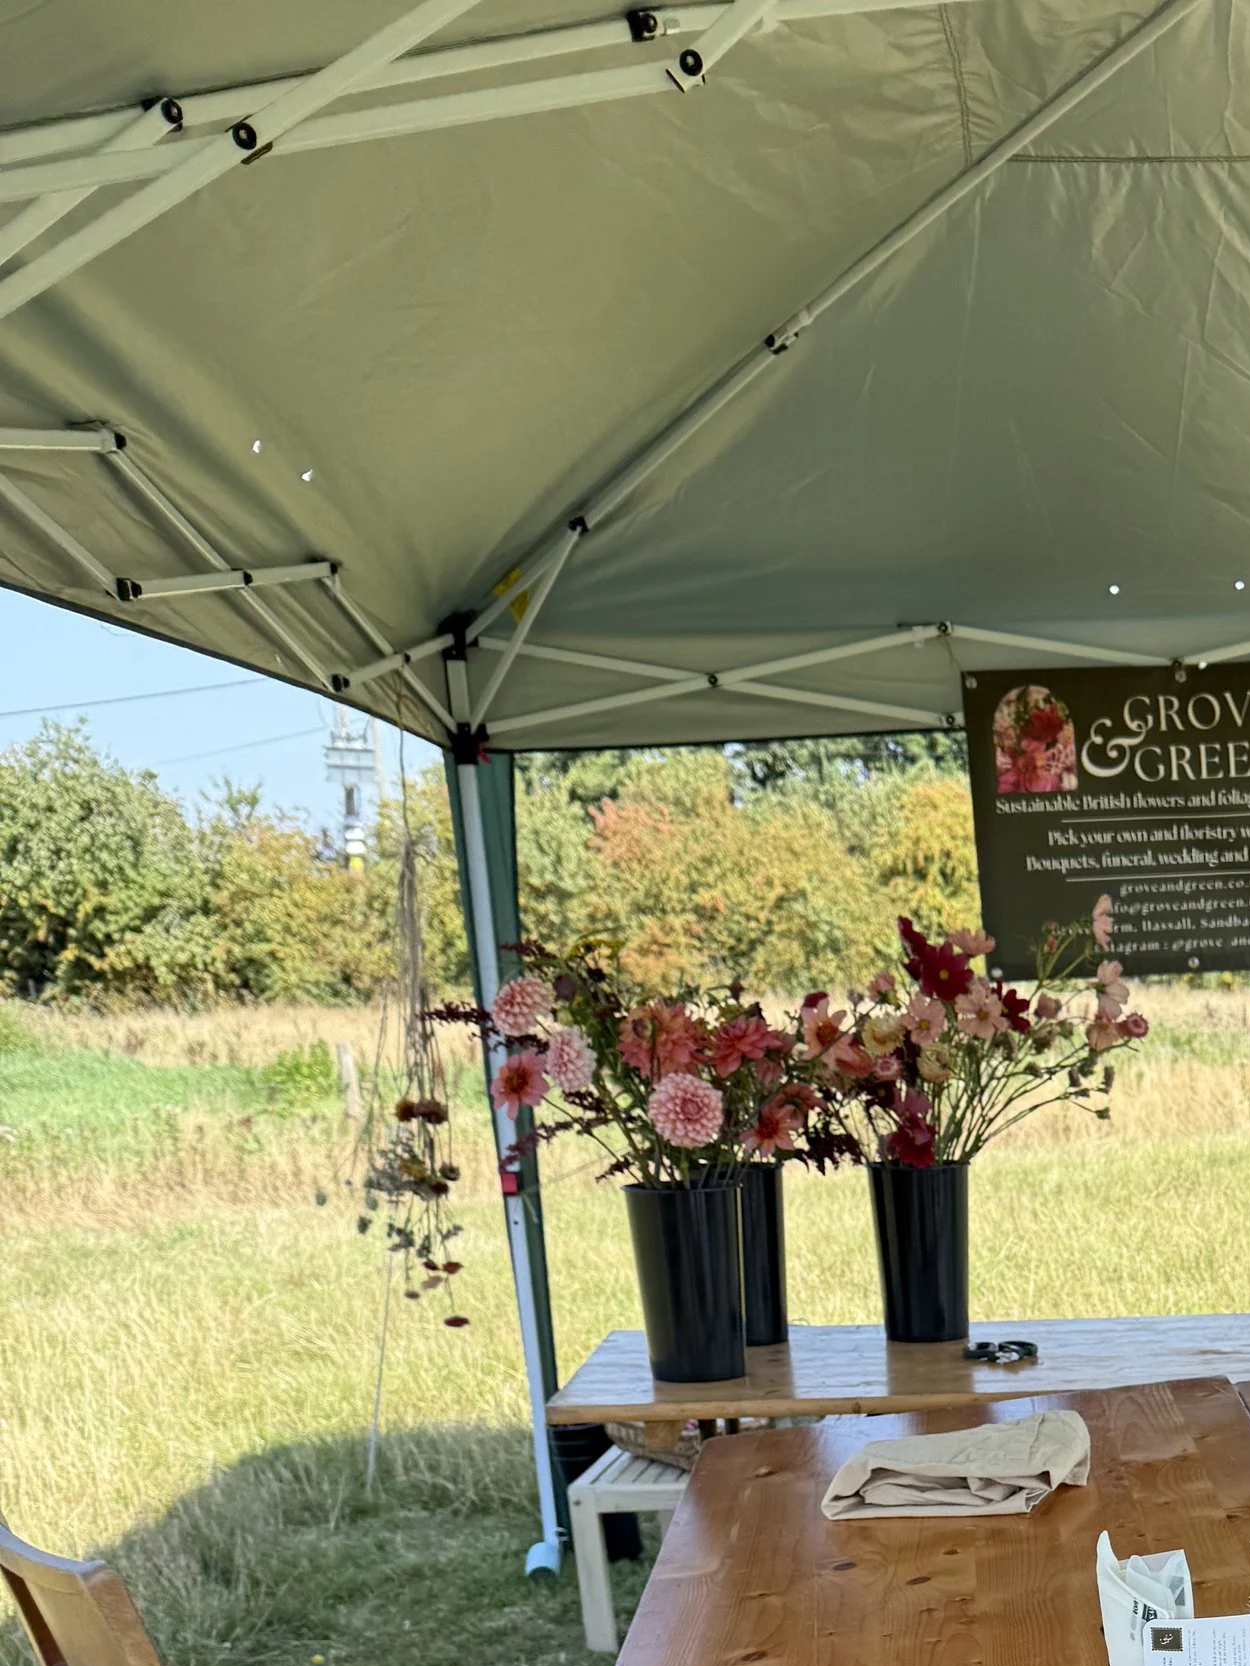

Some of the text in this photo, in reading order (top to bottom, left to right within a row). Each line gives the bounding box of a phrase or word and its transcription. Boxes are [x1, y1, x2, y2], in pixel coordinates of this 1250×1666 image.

[1081, 718, 1146, 778] &
[996, 793, 1081, 814] Sustainable
[1083, 792, 1131, 811] British
[1133, 791, 1185, 809] flowers
[1187, 788, 1216, 808] and
[1048, 827, 1079, 846] Pick
[1080, 831, 1114, 848] your
[1116, 829, 1148, 844] own
[1150, 823, 1177, 842] and
[1180, 822, 1236, 842] floristry
[1026, 854, 1100, 874] Bouquets,
[1102, 849, 1157, 868] funeral,
[1157, 846, 1219, 868] wedding
[1220, 844, 1249, 863] and
[1142, 917, 1196, 931] Hassall,
